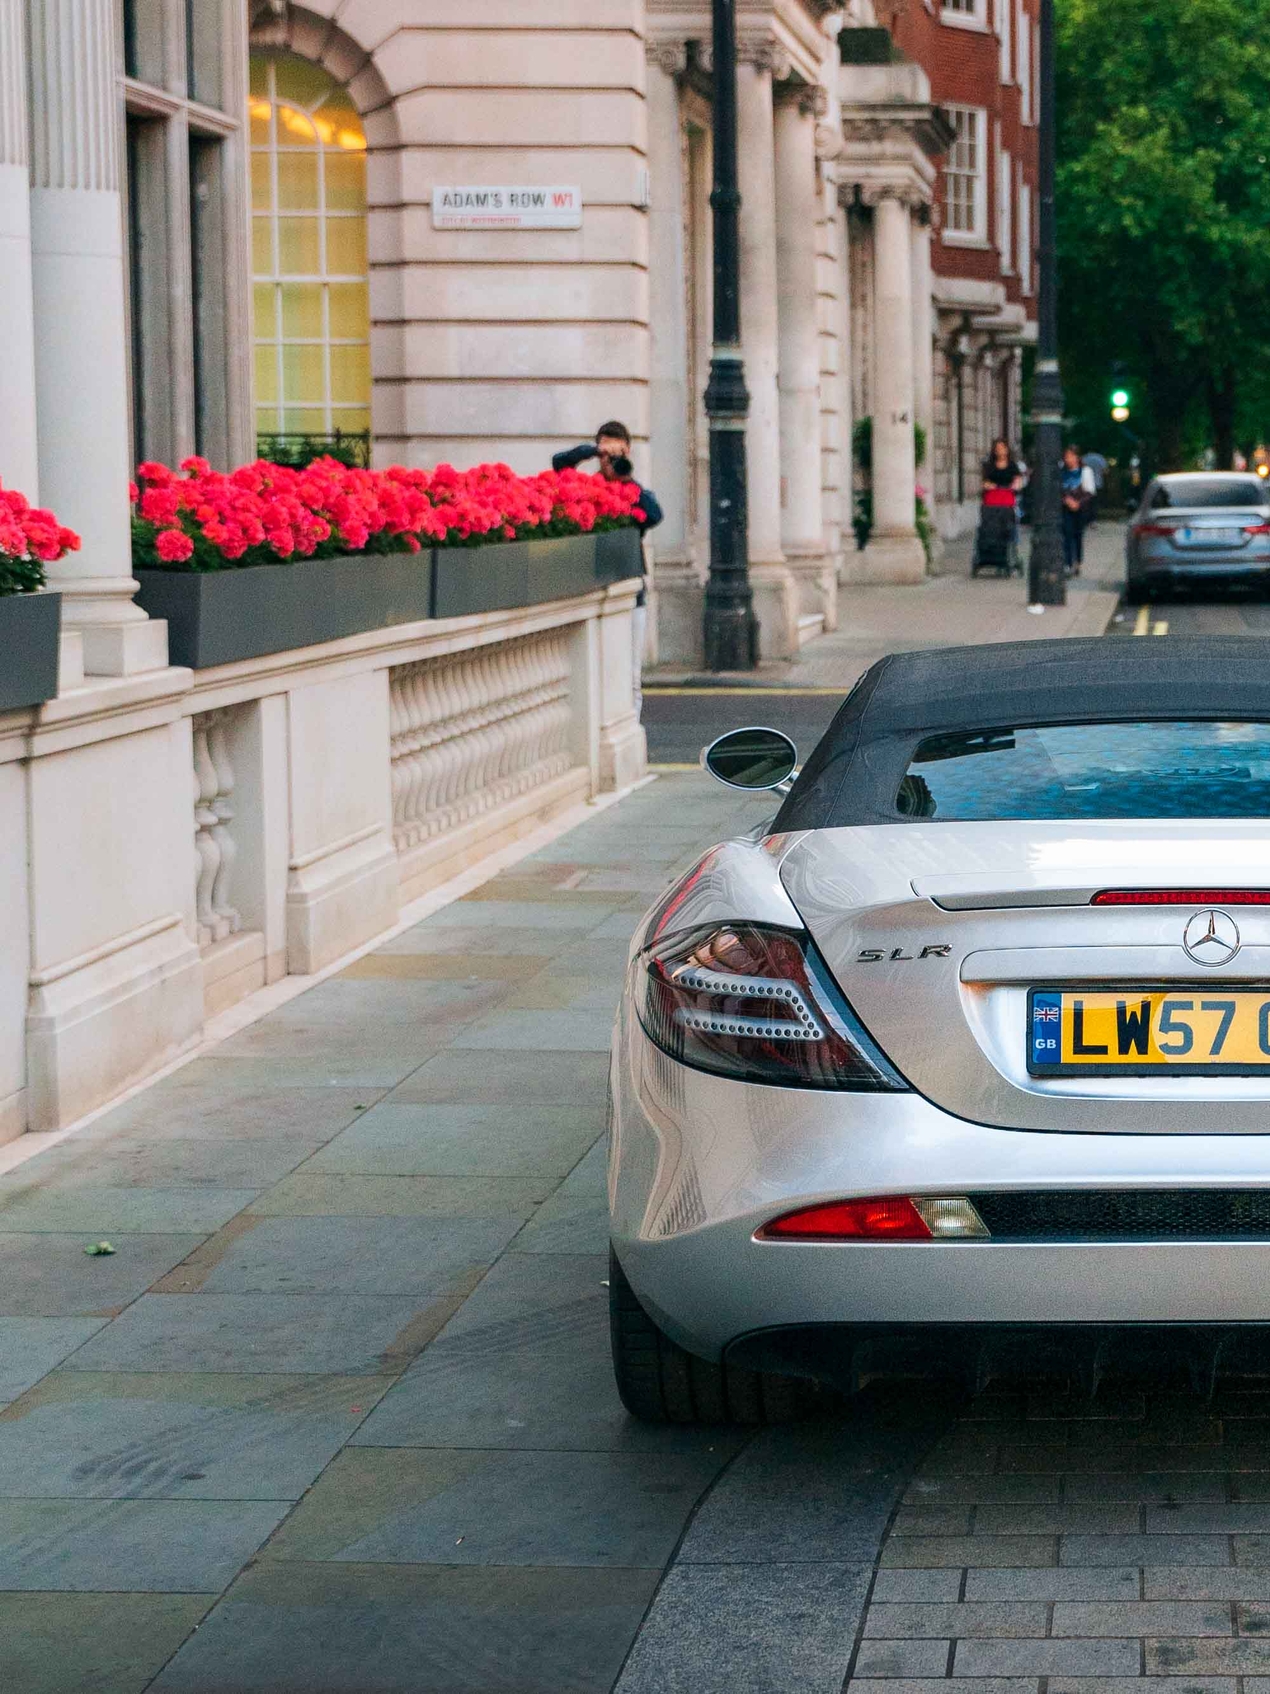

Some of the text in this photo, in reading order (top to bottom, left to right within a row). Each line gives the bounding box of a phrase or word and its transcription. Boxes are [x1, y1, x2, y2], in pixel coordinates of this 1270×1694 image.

[442, 192, 574, 208] ADAM'S ROW W1
[856, 944, 952, 962] SLR
[1072, 1000, 1236, 1056] LW57
[1035, 1038, 1057, 1050] GB
